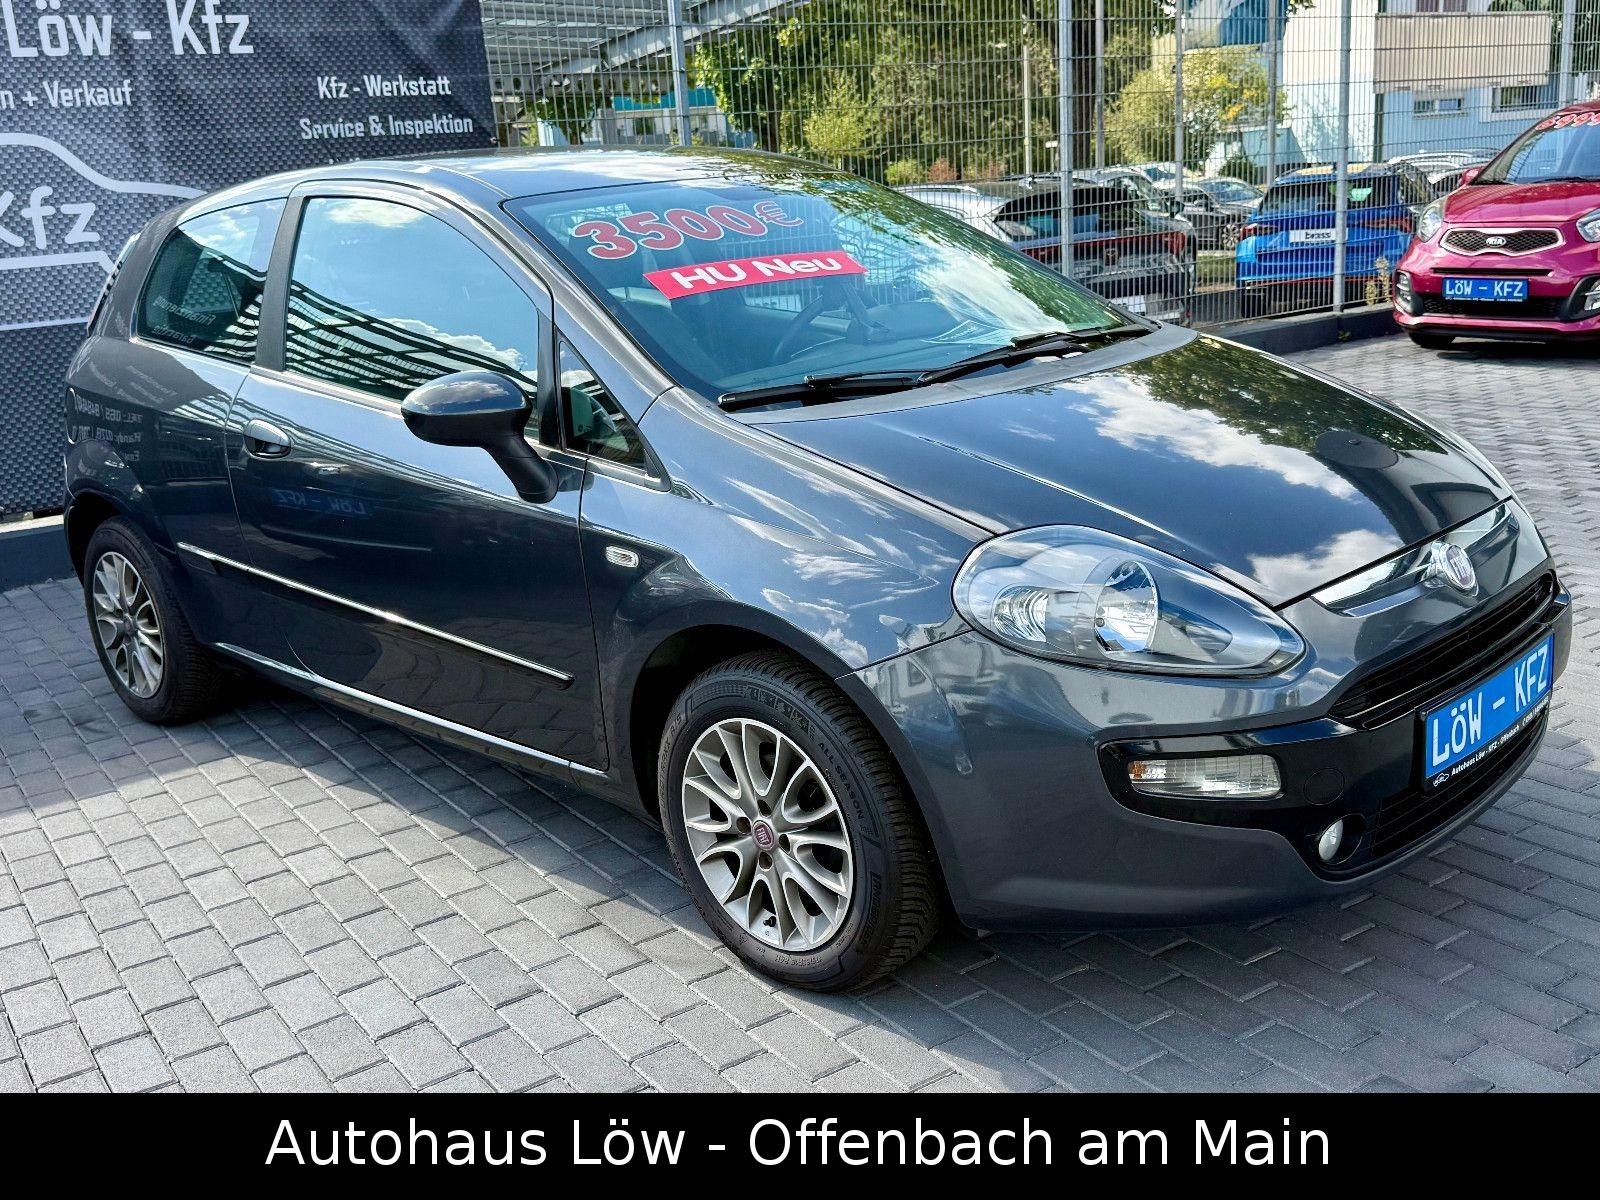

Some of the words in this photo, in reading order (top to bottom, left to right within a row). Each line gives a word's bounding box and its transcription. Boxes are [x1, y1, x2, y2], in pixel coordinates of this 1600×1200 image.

[1, 0, 112, 57] Löw
[133, 31, 151, 40] -
[166, 0, 254, 55] Kfz
[22, 91, 38, 106] +
[42, 79, 132, 107] Verkauf
[317, 75, 349, 99] Kfz
[363, 74, 451, 97] Werkstatt
[300, 117, 364, 140] Service
[368, 115, 386, 137] &
[388, 113, 473, 138] Inspektion
[572, 200, 804, 260] 3500€
[670, 263, 747, 289] HU
[751, 257, 842, 277] Neu
[1494, 281, 1523, 296] KFZ
[1493, 696, 1505, 710] -
[1515, 644, 1548, 712] KFZ
[818, 742, 834, 765] ALL
[835, 765, 865, 820] SEASON
[1451, 757, 1475, 776] Autohaus
